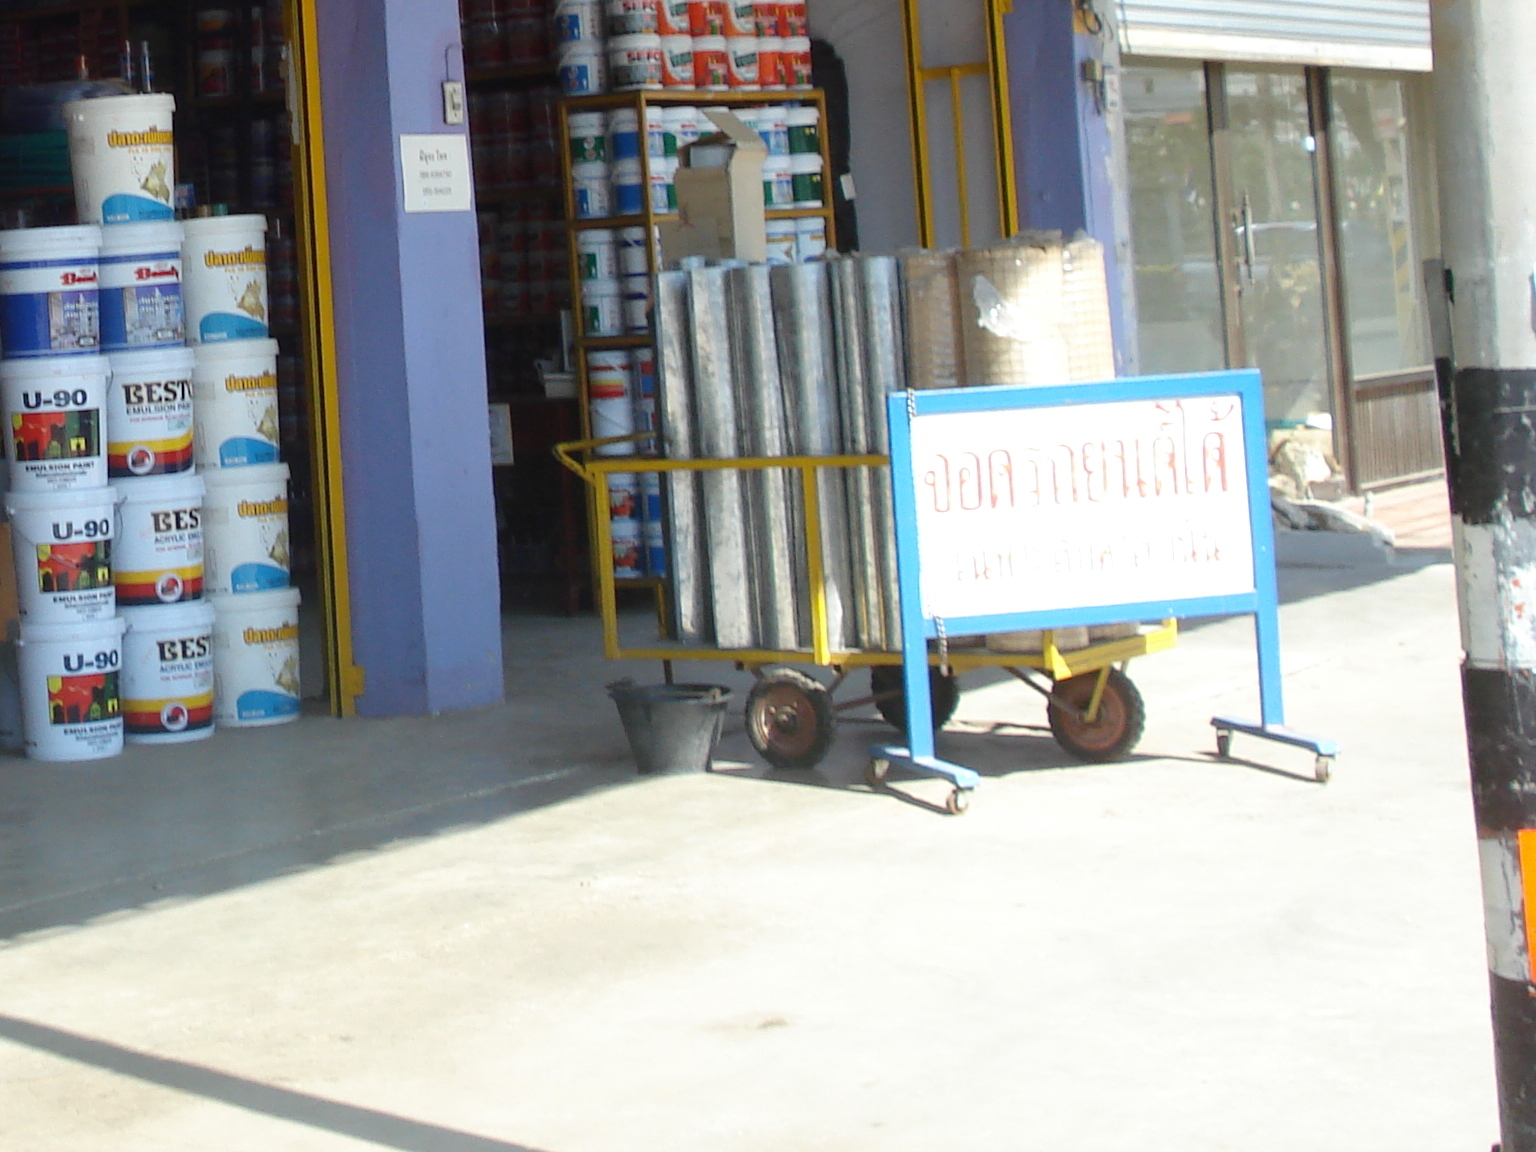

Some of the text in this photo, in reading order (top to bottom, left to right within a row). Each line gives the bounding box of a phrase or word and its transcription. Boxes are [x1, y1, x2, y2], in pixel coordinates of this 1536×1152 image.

[23, 389, 87, 409] U-90
[52, 518, 109, 540] U-90
[63, 649, 118, 672] U-90
